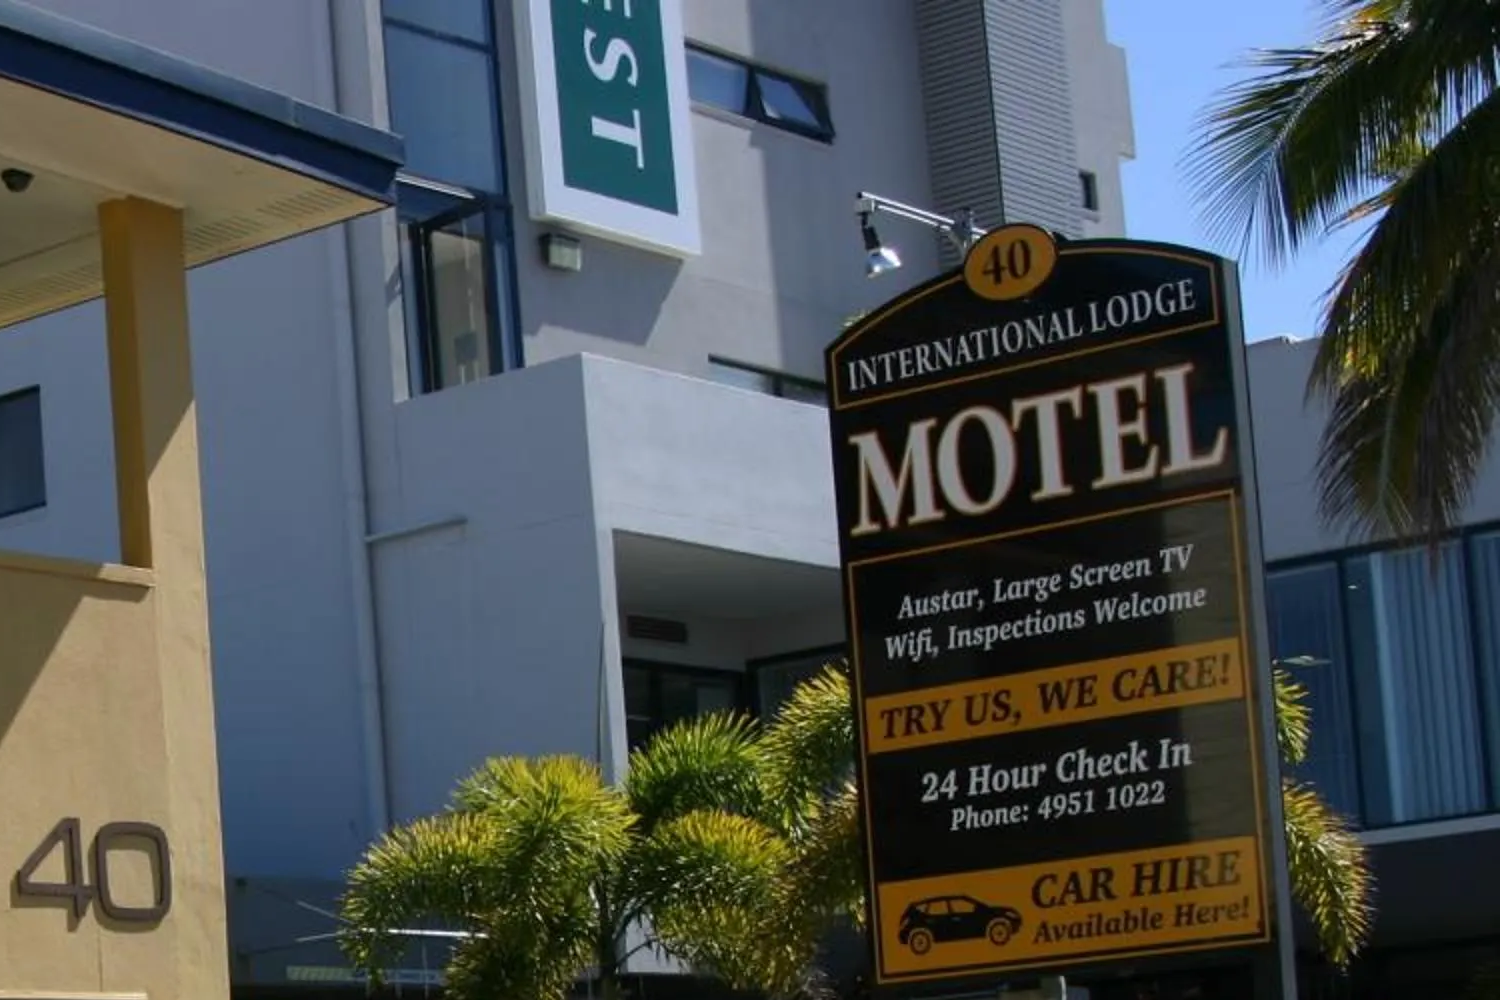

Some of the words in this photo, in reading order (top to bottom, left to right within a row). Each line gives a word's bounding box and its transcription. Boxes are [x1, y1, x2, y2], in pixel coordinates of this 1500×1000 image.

[982, 239, 1032, 285] 40
[847, 308, 1083, 392] INTERNATIONAL
[1091, 279, 1197, 332] LODGE
[848, 362, 1230, 536] MOTEL
[897, 588, 985, 621] Austar,
[992, 573, 1062, 604] Large
[1069, 556, 1153, 589] Screen
[1160, 543, 1194, 574] TV
[885, 630, 940, 662] Wifi,
[947, 605, 1085, 653] Inspections
[1093, 586, 1207, 624] Welcome
[880, 699, 953, 740] TRY
[964, 689, 1023, 727] US,
[1037, 674, 1099, 715] WE
[1111, 652, 1232, 699] CARE!
[921, 770, 959, 802] 24
[967, 760, 1047, 797] Hour
[1055, 739, 1149, 784] Check
[1158, 738, 1193, 770] In
[950, 800, 1029, 832] Phone:
[1037, 790, 1095, 822] 4951
[1106, 780, 1166, 812] 1022
[17, 816, 172, 923] 40
[1031, 866, 1115, 910] CAR
[1131, 850, 1242, 898] HIRE
[1032, 907, 1164, 945] Available
[1173, 895, 1251, 928] Here!
